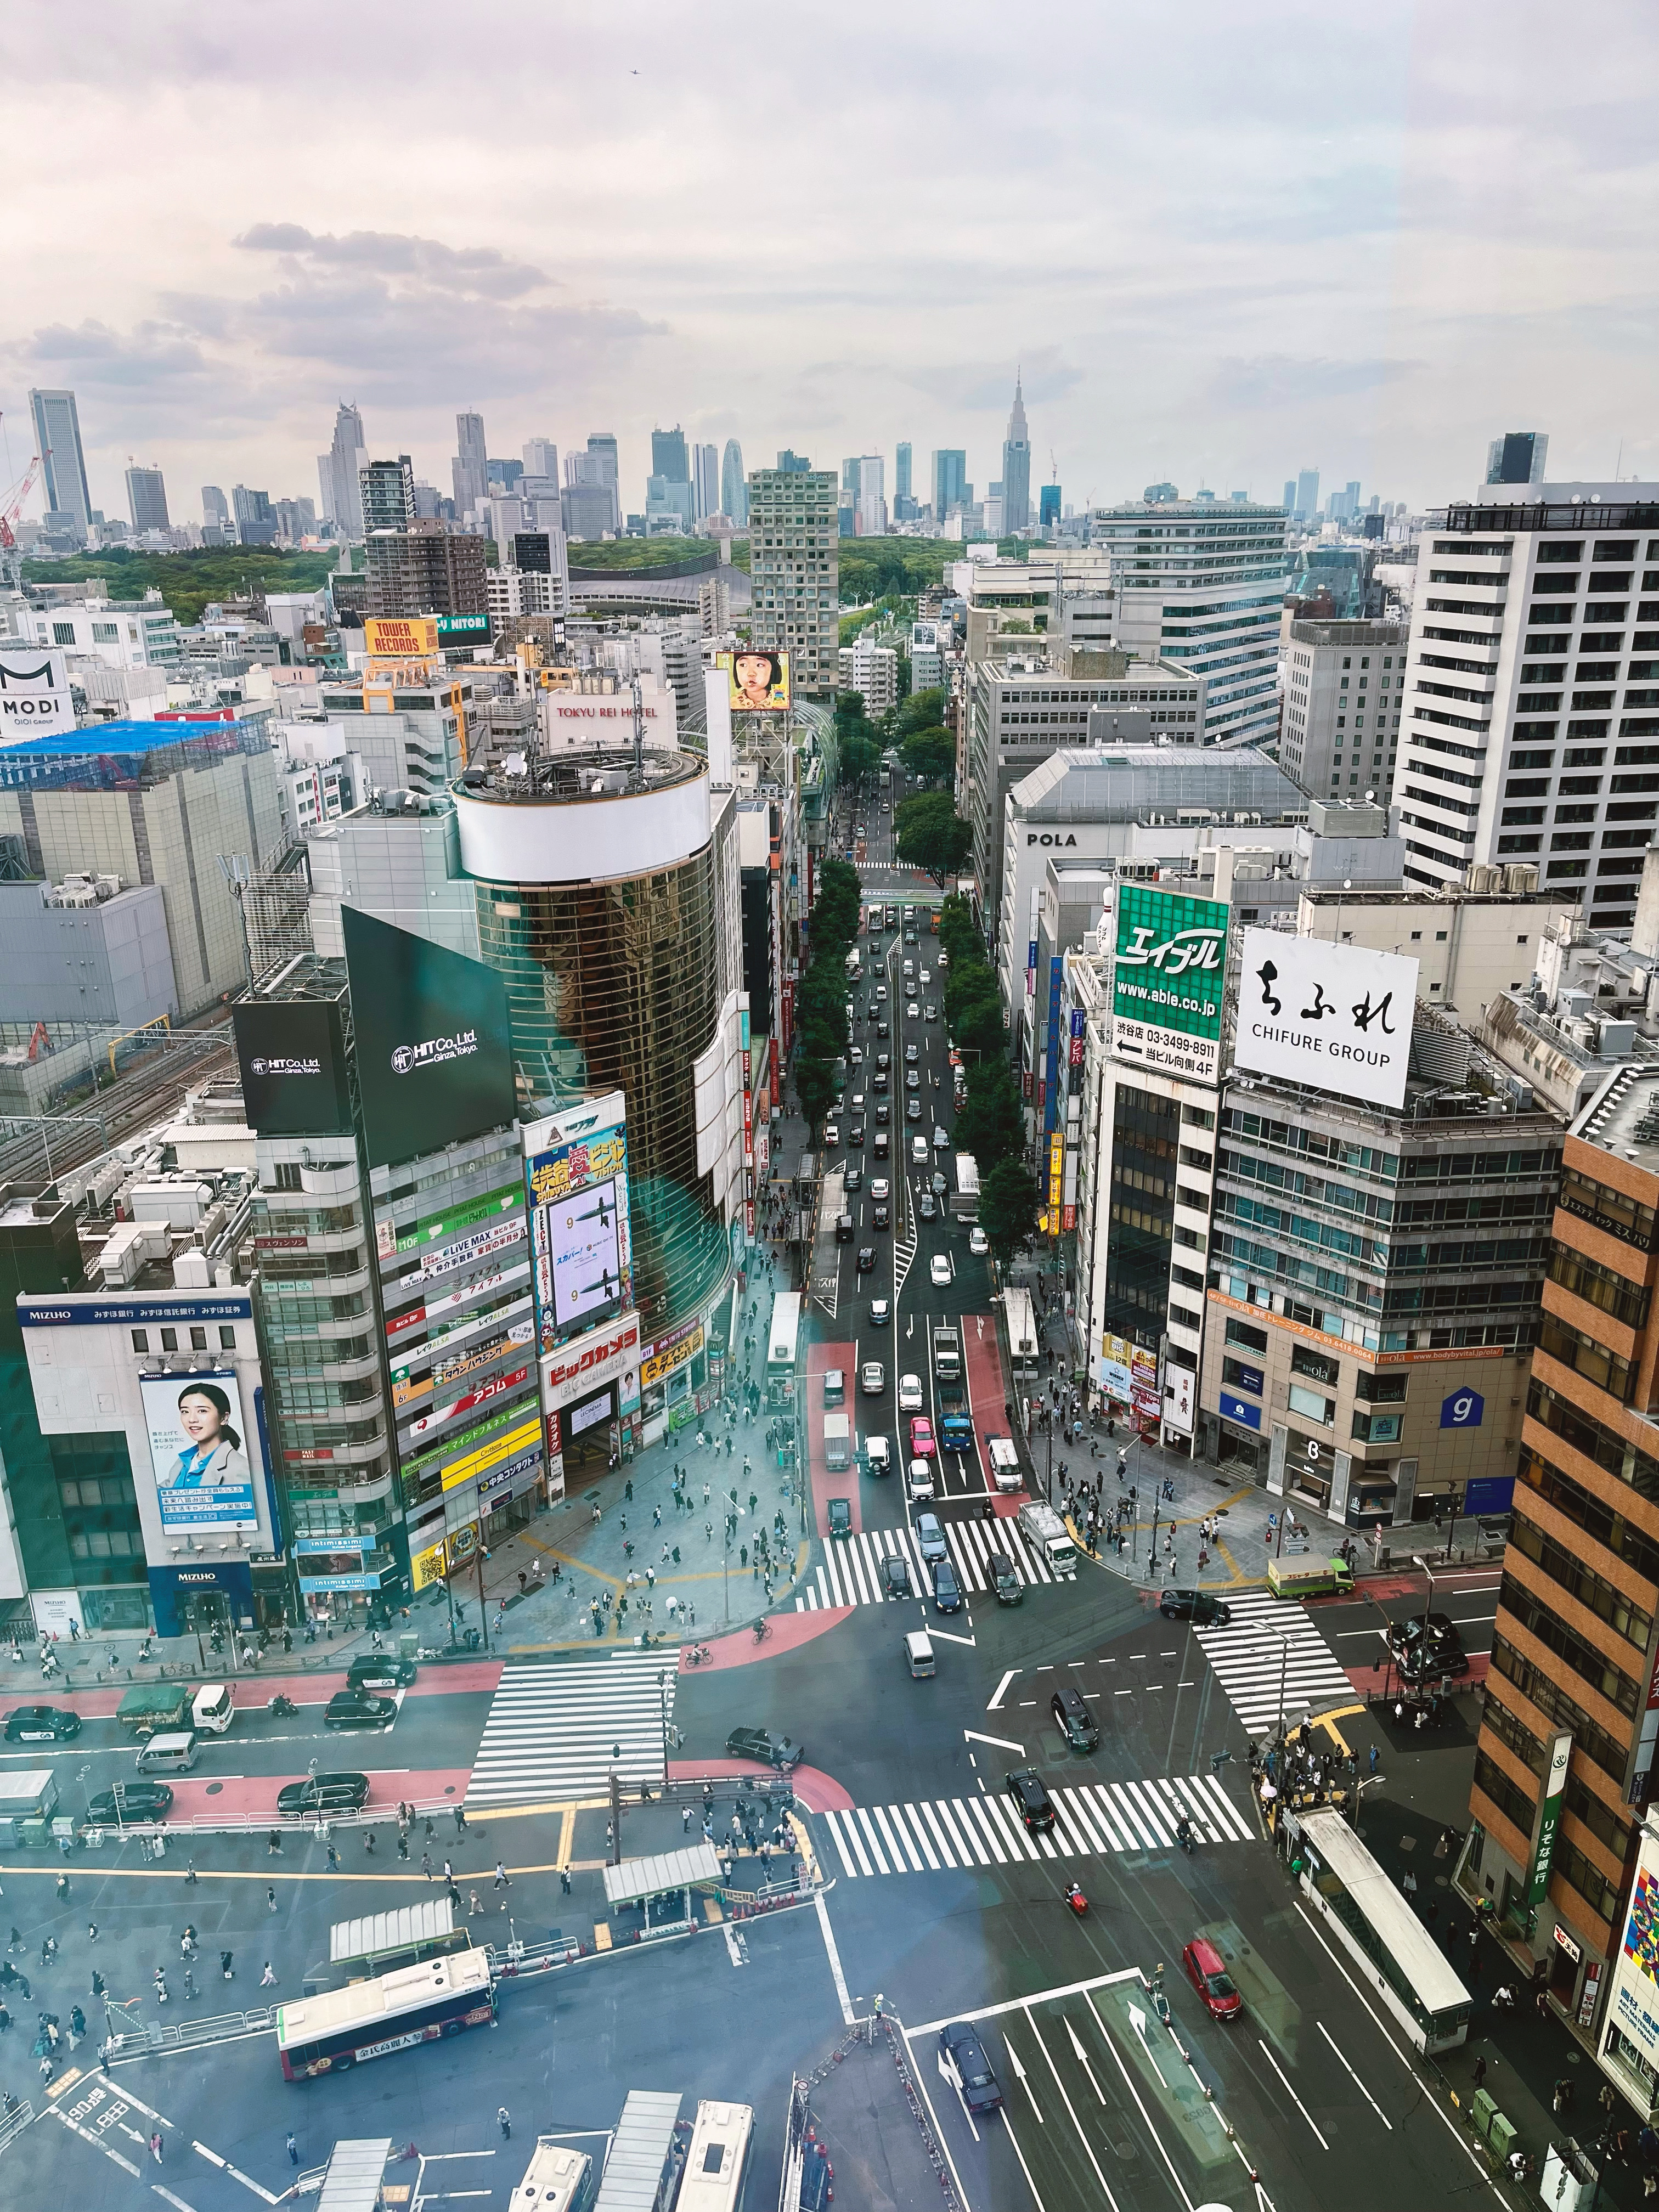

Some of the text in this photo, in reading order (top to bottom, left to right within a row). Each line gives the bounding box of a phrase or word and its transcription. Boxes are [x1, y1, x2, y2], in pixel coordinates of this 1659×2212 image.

[376, 623, 411, 636] TOWER
[451, 617, 485, 630] NITORI
[375, 638, 419, 651] RECORDS
[3, 699, 59, 714] MODI
[557, 708, 616, 717] TOKYU REI
[1028, 834, 1076, 846] POLA
[1114, 927, 1225, 974] エイブル
[1118, 981, 1215, 1017] www.able.co.jp
[1256, 960, 1396, 1034] ちふれ
[414, 1041, 435, 1058] HIT
[1117, 1022, 1214, 1058] 渋谷店 03-3499-8911
[1252, 1023, 1390, 1068] CHIFURE GROUP
[1072, 1040, 1080, 1062] アビバ
[1146, 1047, 1212, 1075] 当ビル向側 4F
[537, 1161, 623, 1202] SHIBUYA AI VISION
[419, 1220, 431, 1228] PITAT
[433, 1211, 451, 1223] HOUSE
[454, 1205, 467, 1214] PITAT
[468, 1198, 486, 1208] HOUSE
[505, 1184, 522, 1194] HOUSE
[567, 1217, 574, 1229] 9
[402, 1237, 418, 1250] 10F
[450, 1231, 490, 1255] LiVE MAX
[412, 1277, 422, 1285] MAX
[571, 1290, 578, 1301] 9
[30, 1311, 71, 1320] MIZUHO
[94, 1306, 241, 1319] みずほ銀行 みずほ信託銀行 みずほ証券
[479, 1308, 509, 1327] レイクALSA
[669, 1320, 696, 1344] TAITO STATION
[1111, 1338, 1124, 1346] MEGA
[1252, 1308, 1372, 1359] 加圧トレーニング ジム 03.6418.0064
[416, 1336, 449, 1355] レイクALSA
[642, 1348, 652, 1358] B1F
[1111, 1344, 1125, 1353] BIG
[1413, 1348, 1500, 1360] www.bodybyvital.jp/ola/
[445, 1344, 505, 1380] タウンハウジング
[550, 1326, 637, 1386] ビックカメラ
[516, 1369, 526, 1381] 5F
[561, 1379, 580, 1397] BIC
[582, 1354, 627, 1385] CAMERA
[1109, 1371, 1124, 1382] WINNER
[398, 1394, 408, 1403] 6F
[473, 1381, 506, 1404] アコム
[1146, 1392, 1160, 1404] TOP1
[1453, 1397, 1473, 1421] g
[451, 1416, 507, 1448] マインドフルネス
[550, 1414, 559, 1451] カラオケ
[481, 1442, 502, 1457] CityHome
[489, 1457, 533, 1487] 中央コンタクト
[165, 1503, 251, 1513] 新生活キャンペーン実施中!
[178, 1573, 216, 1582] MIZUHO
[1534, 1820, 1555, 1884] りそな銀行
[1618, 2005, 1655, 2049] PICTURE FRAME
[1620, 1999, 1656, 2041] ART MATERIALS
[359, 2032, 422, 2058] 金氏高麗人参
[68, 2087, 107, 2121] 都06
[89, 2100, 131, 2136] 田87
